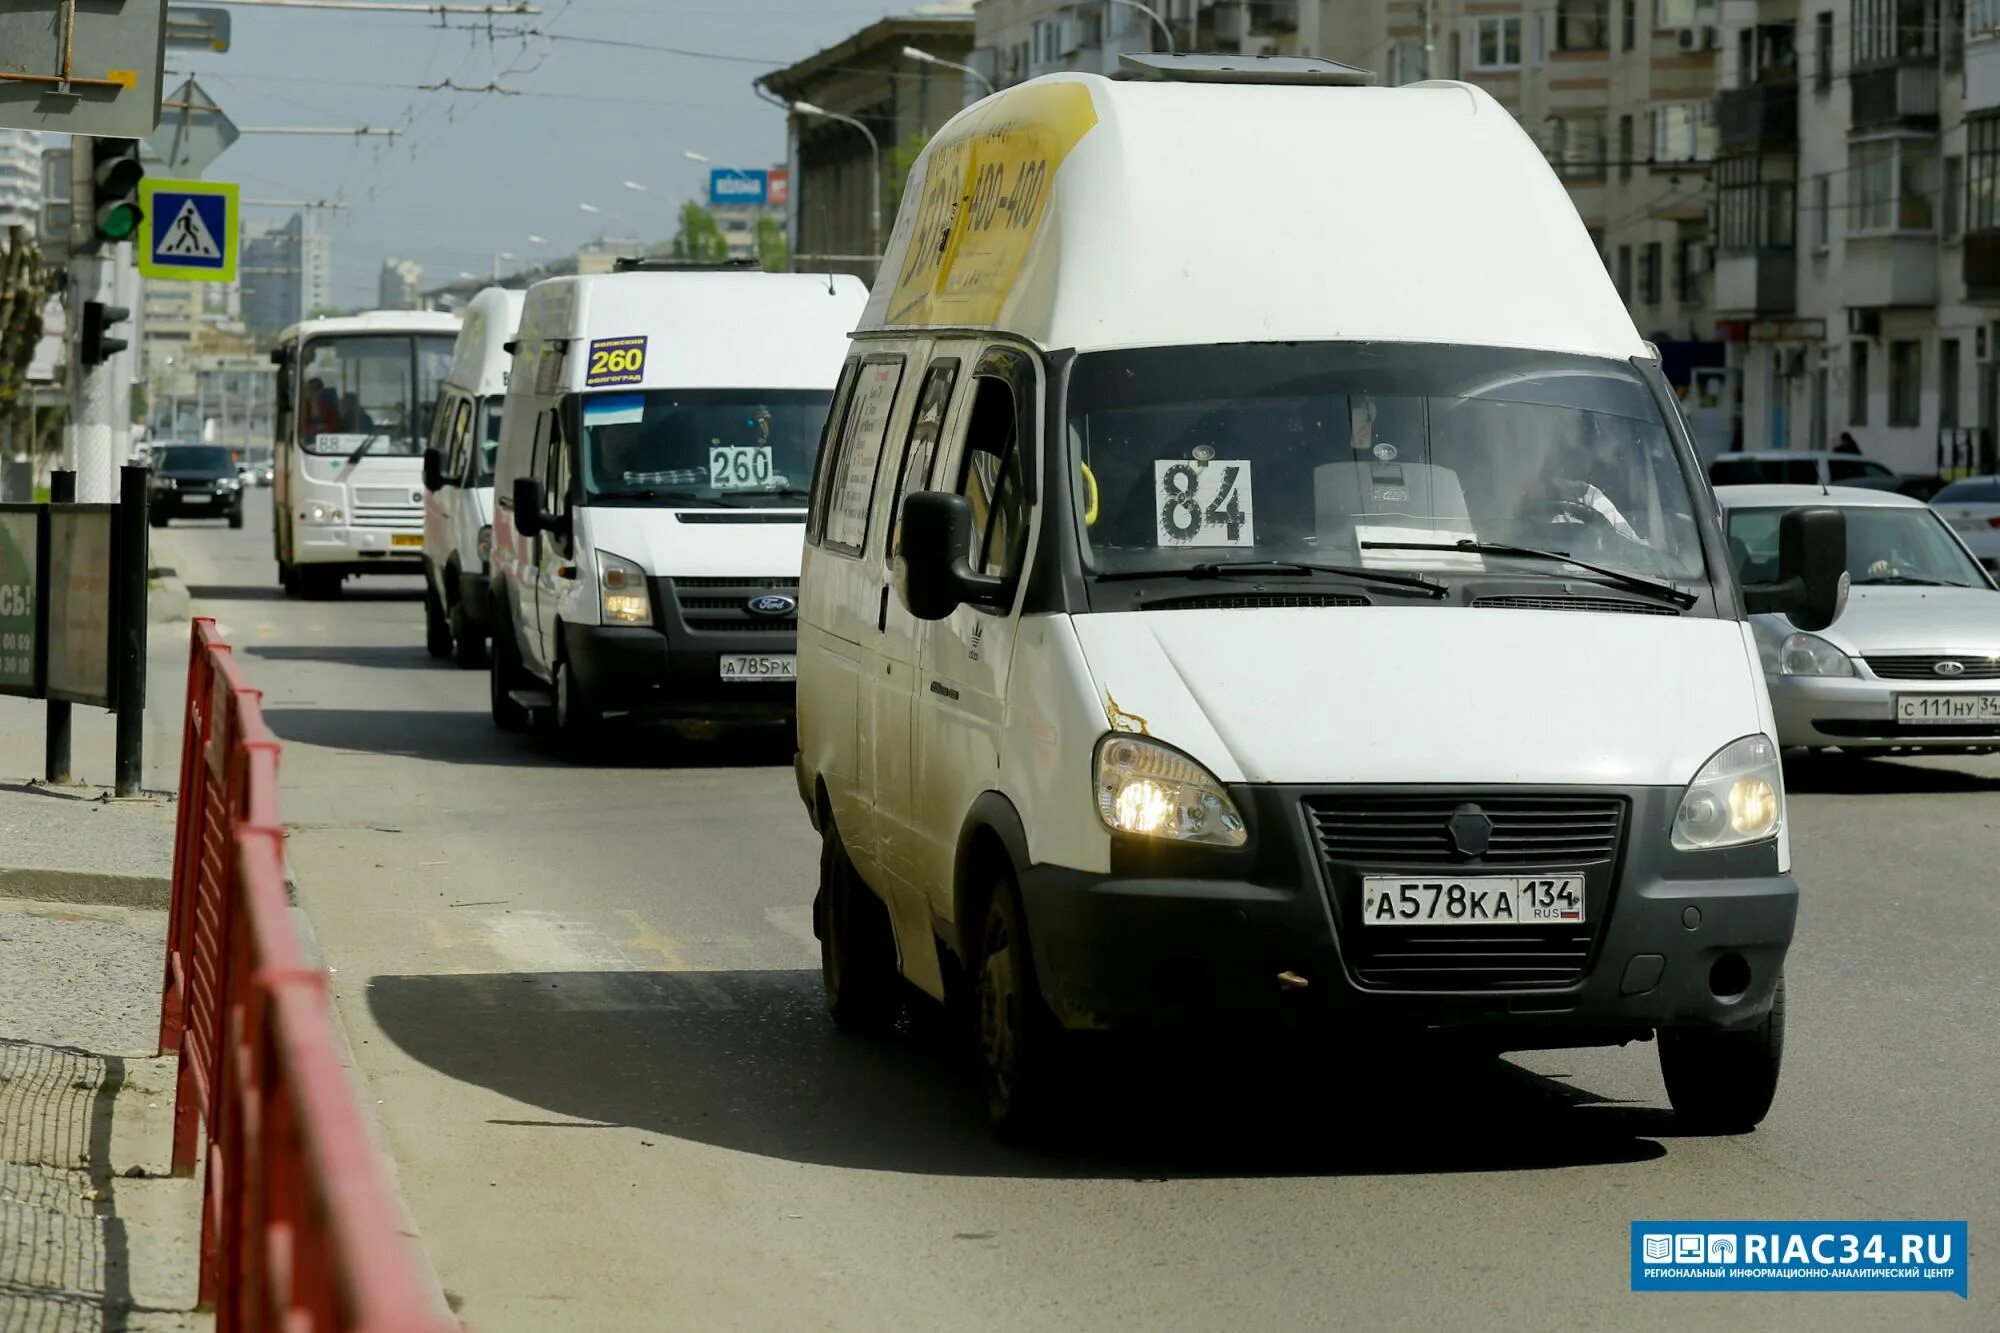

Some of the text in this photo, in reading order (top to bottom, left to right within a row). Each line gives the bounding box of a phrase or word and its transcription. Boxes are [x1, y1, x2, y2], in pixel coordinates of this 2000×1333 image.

[590, 348, 643, 375] 260
[587, 374, 642, 385] ВОЛГОГРАД
[713, 450, 769, 484] 260
[1161, 464, 1245, 541] 84
[759, 598, 785, 610] Ford
[726, 658, 792, 675] А785РК
[1980, 697, 1998, 712] 34
[1375, 880, 1574, 920] А578КА 134
[1533, 908, 1560, 919] RUS
